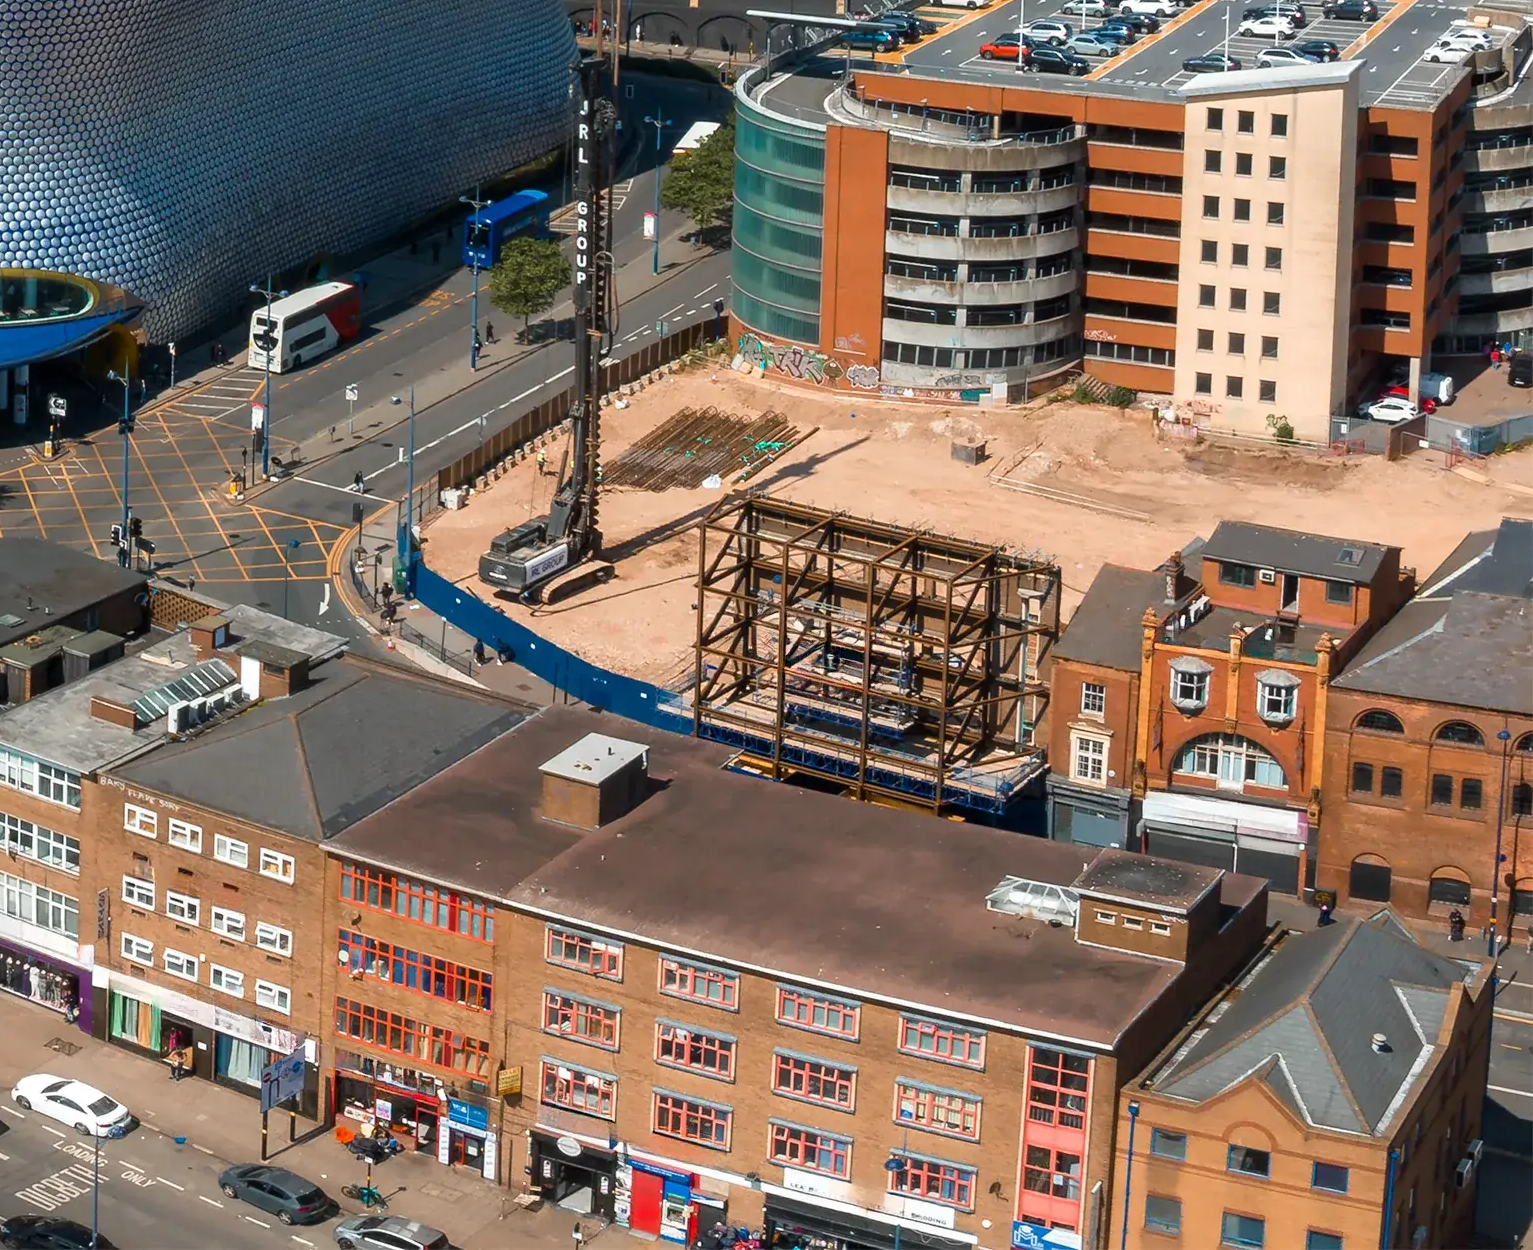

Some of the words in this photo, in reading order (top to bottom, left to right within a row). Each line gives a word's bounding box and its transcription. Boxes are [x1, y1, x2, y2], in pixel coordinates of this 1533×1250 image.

[576, 201, 588, 285] GROUP
[52, 1139, 109, 1169] LOADING
[14, 1162, 110, 1212] DIGBETH
[120, 1169, 158, 1189] ONLY
